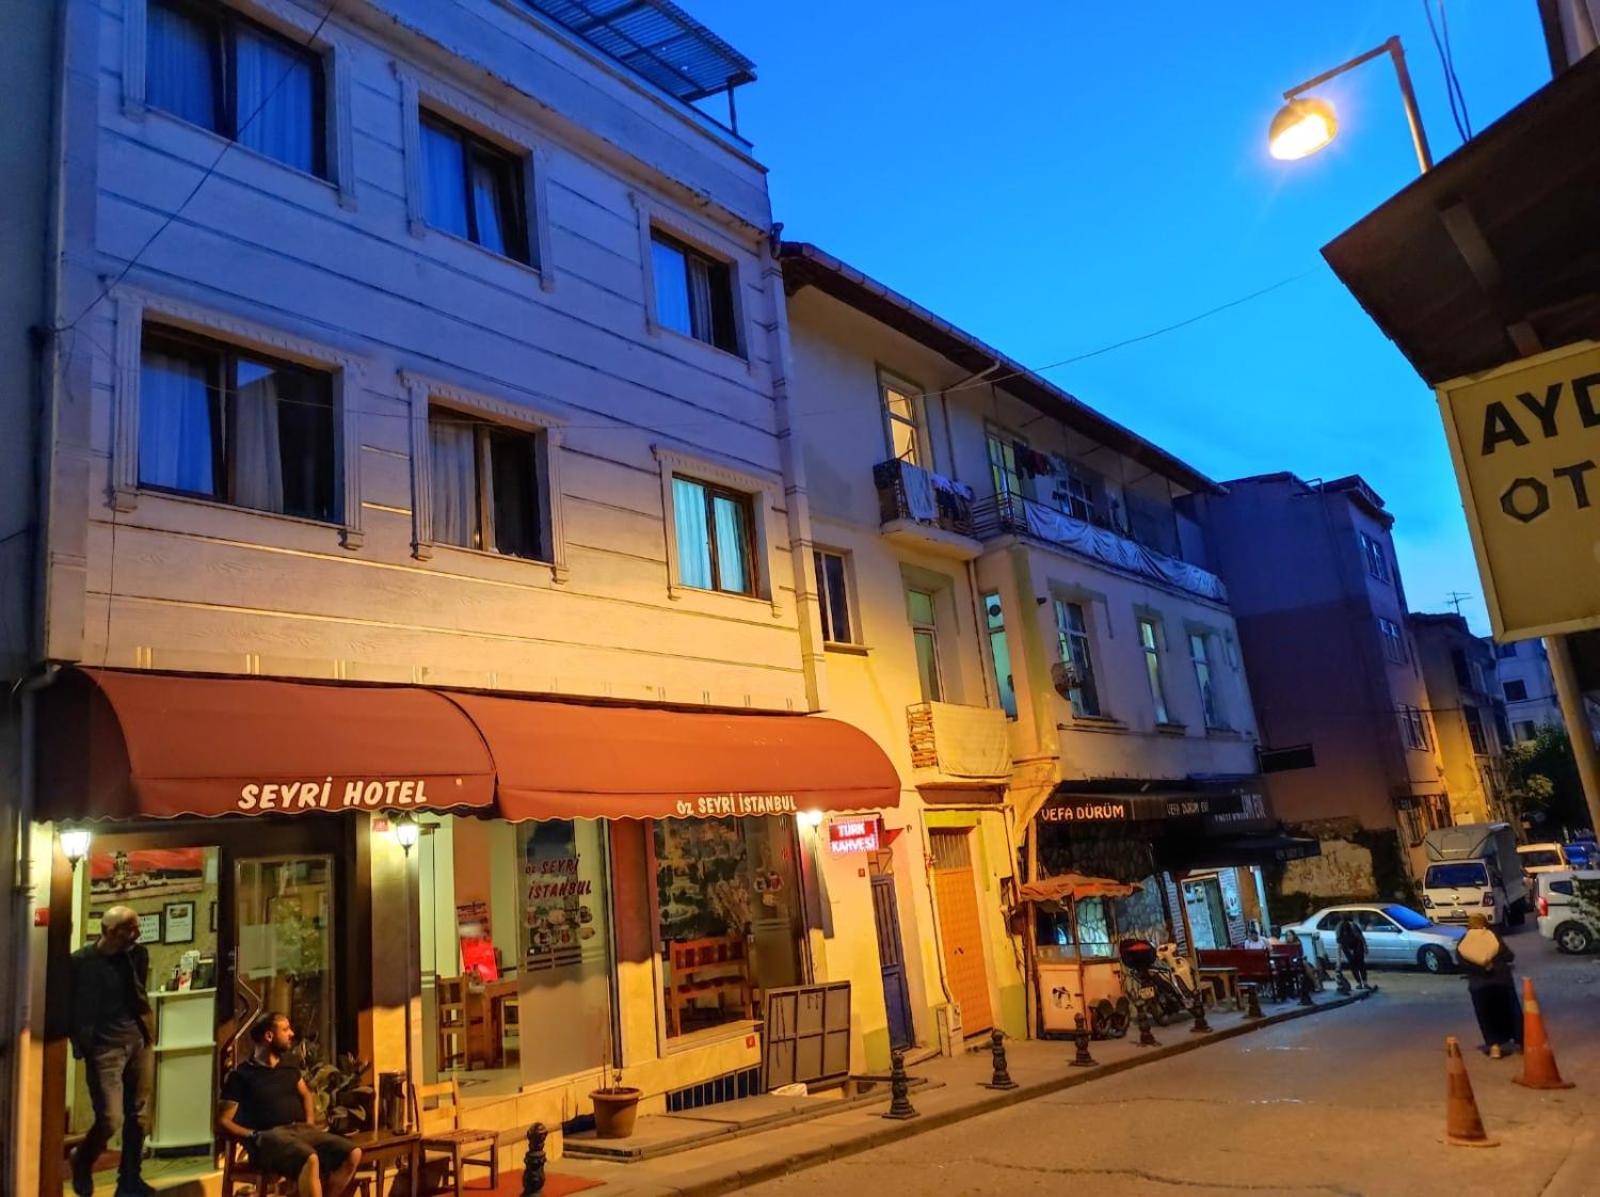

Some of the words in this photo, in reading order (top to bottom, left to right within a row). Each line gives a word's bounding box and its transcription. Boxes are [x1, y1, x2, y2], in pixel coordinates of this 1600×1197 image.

[238, 776, 332, 809] SEYRİ
[343, 780, 428, 806] HOTEL
[698, 793, 735, 814] SEYRİ
[738, 792, 797, 813] İSTANBUL
[1041, 807, 1073, 822] VEFA
[1076, 802, 1125, 821] DÜRÜM
[541, 853, 581, 875] SEYRİ
[528, 879, 592, 900] İSTANBUL
